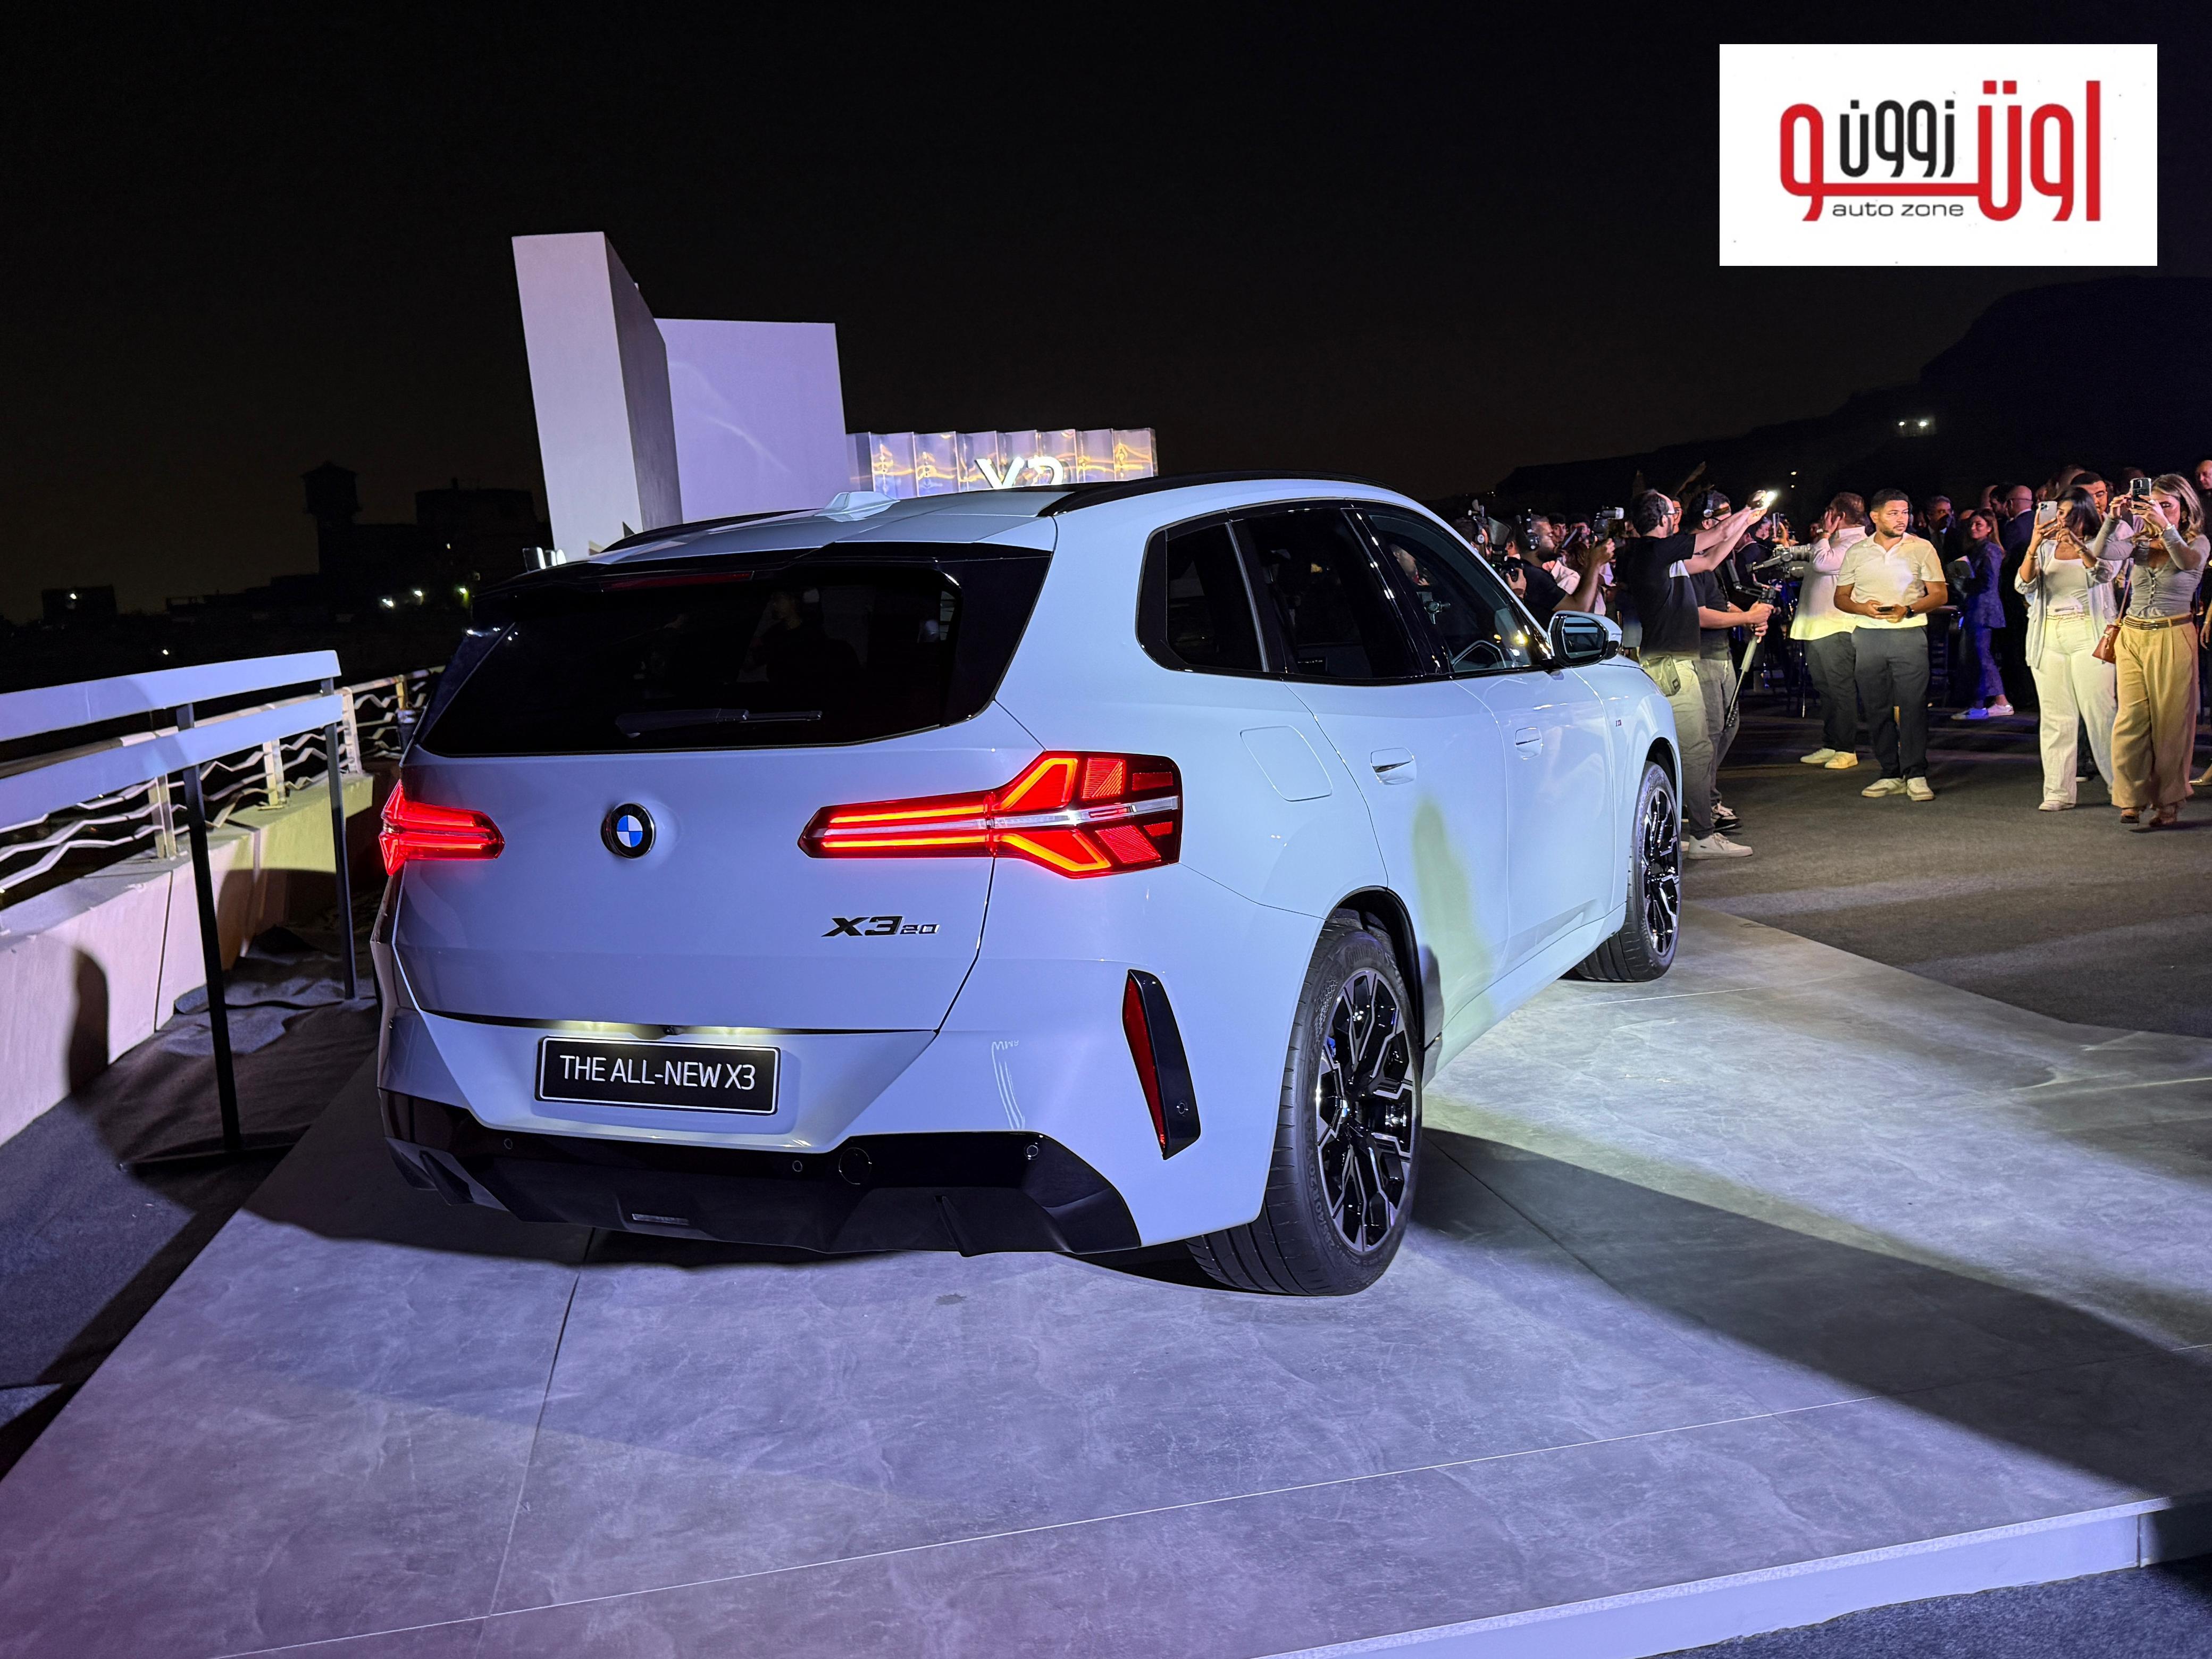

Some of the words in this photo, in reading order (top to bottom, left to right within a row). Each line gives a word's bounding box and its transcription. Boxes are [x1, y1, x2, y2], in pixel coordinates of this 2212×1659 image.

[559, 1055, 607, 1082] THE
[610, 1058, 722, 1088] ALL-NEW
[725, 1063, 756, 1091] X3
